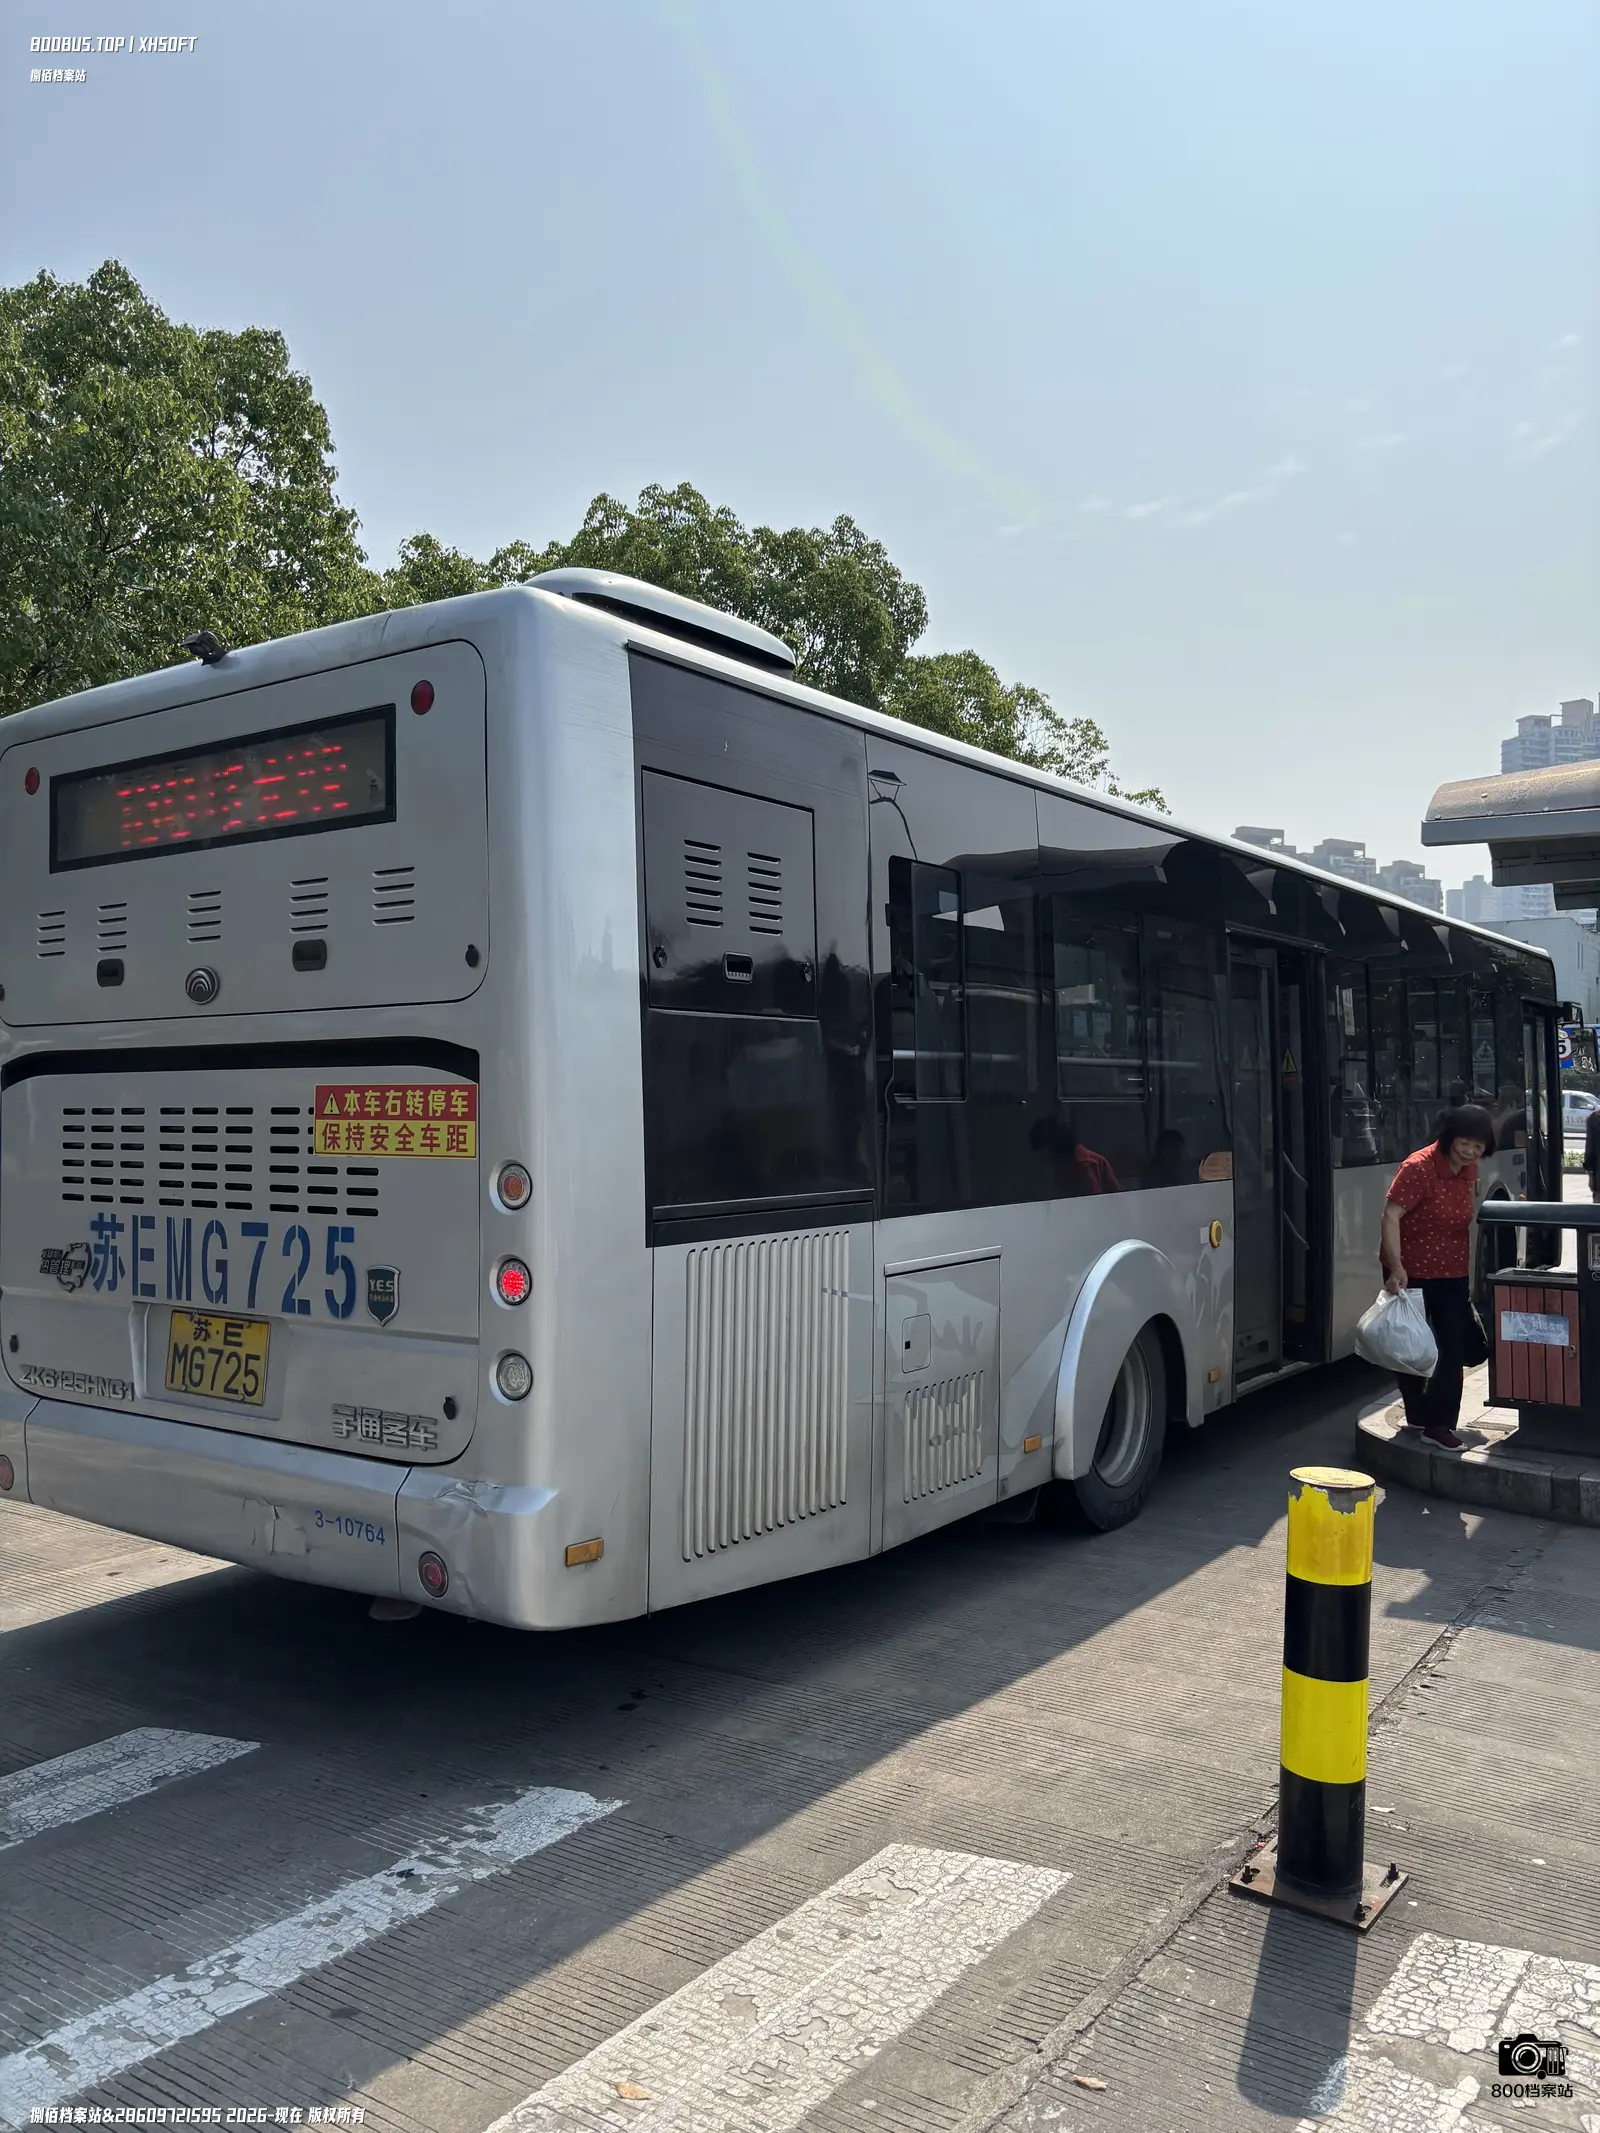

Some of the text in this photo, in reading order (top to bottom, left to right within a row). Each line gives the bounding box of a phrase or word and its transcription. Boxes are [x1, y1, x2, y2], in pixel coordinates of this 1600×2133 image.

[344, 1089, 469, 1117] 本车右转停车
[321, 1123, 469, 1153] 保持安全车距
[90, 1213, 356, 1319] 苏EMG725
[170, 1342, 261, 1397] MG725
[332, 1403, 438, 1452] 宇通客车
[315, 1510, 386, 1545] 3-10764
